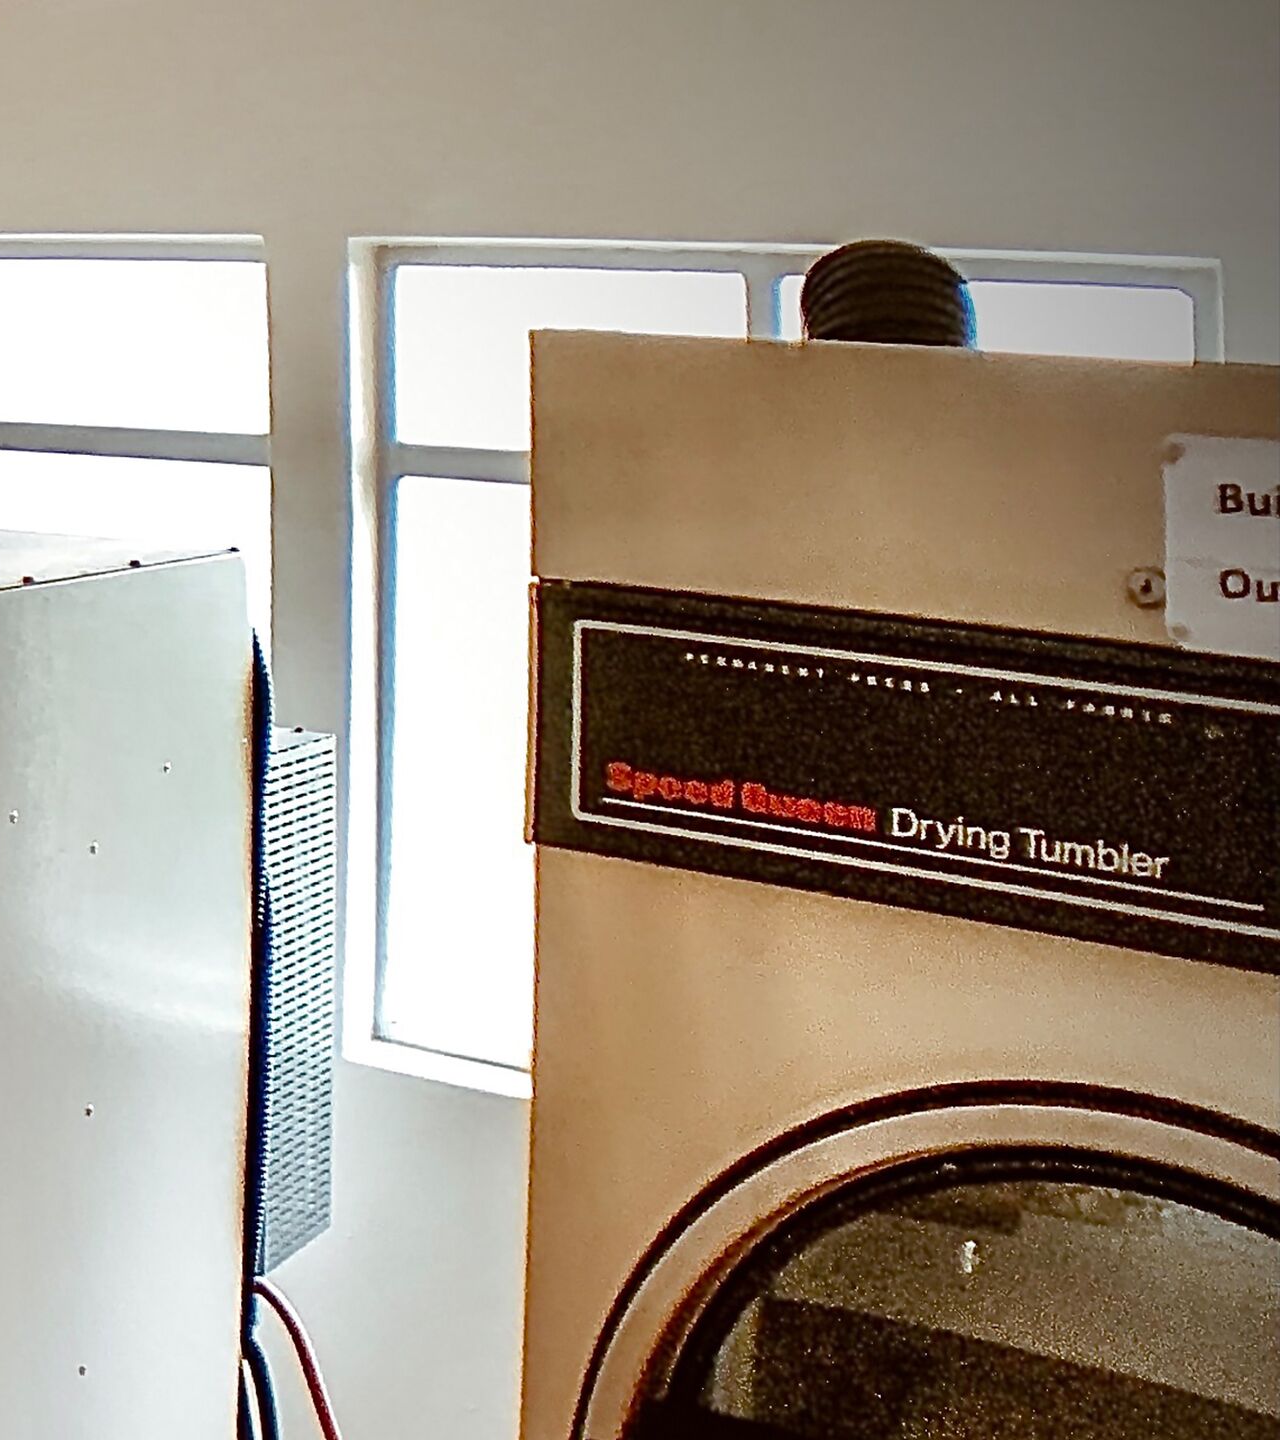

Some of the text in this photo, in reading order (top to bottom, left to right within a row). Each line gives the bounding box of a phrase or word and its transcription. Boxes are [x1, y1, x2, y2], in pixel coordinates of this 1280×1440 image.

[606, 760, 1171, 880] Speed Queen Drying Tumbler
